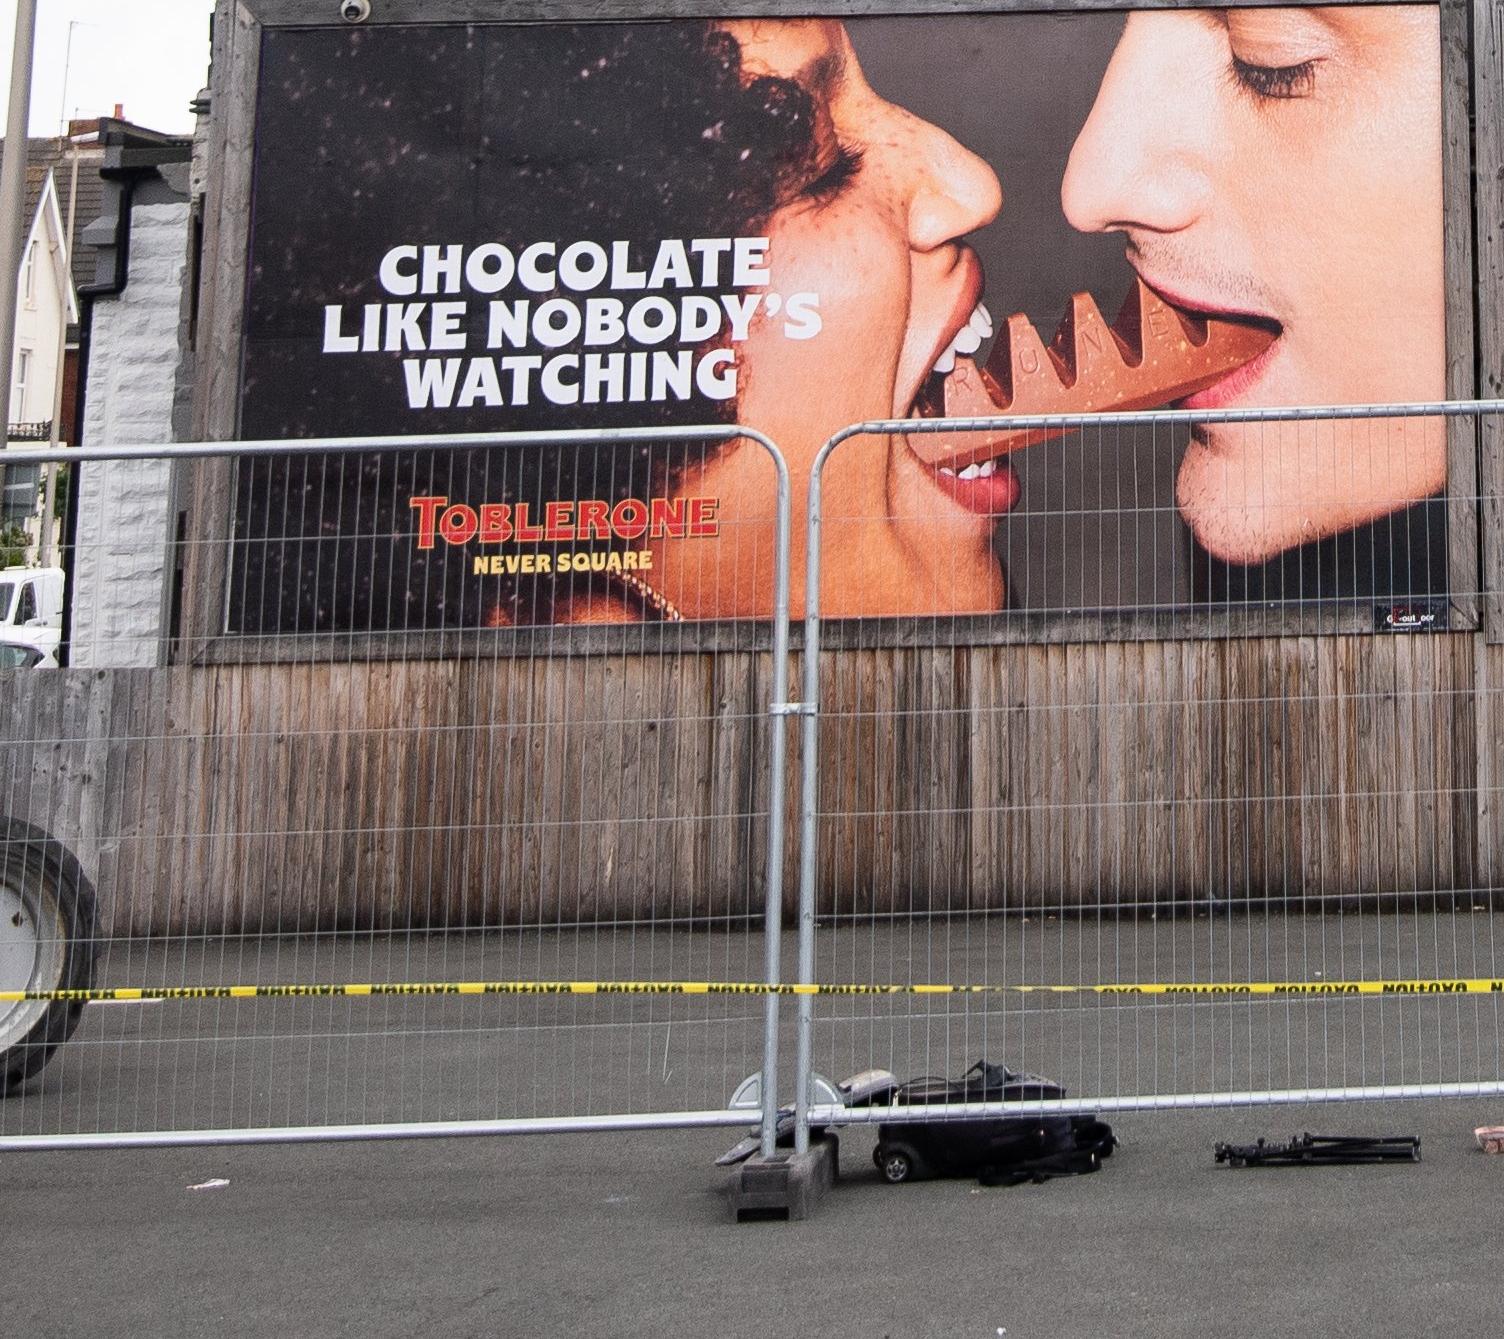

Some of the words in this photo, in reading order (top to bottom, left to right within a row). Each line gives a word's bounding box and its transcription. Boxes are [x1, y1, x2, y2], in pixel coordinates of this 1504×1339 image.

[379, 237, 770, 295] CHOCOLATE
[322, 299, 467, 353] LIKE
[486, 292, 823, 349] NOBODY'S
[403, 348, 737, 408] WATCHING
[410, 497, 719, 548] TOBLERONE
[474, 553, 549, 574] NEVER
[558, 551, 653, 572] SQUARE
